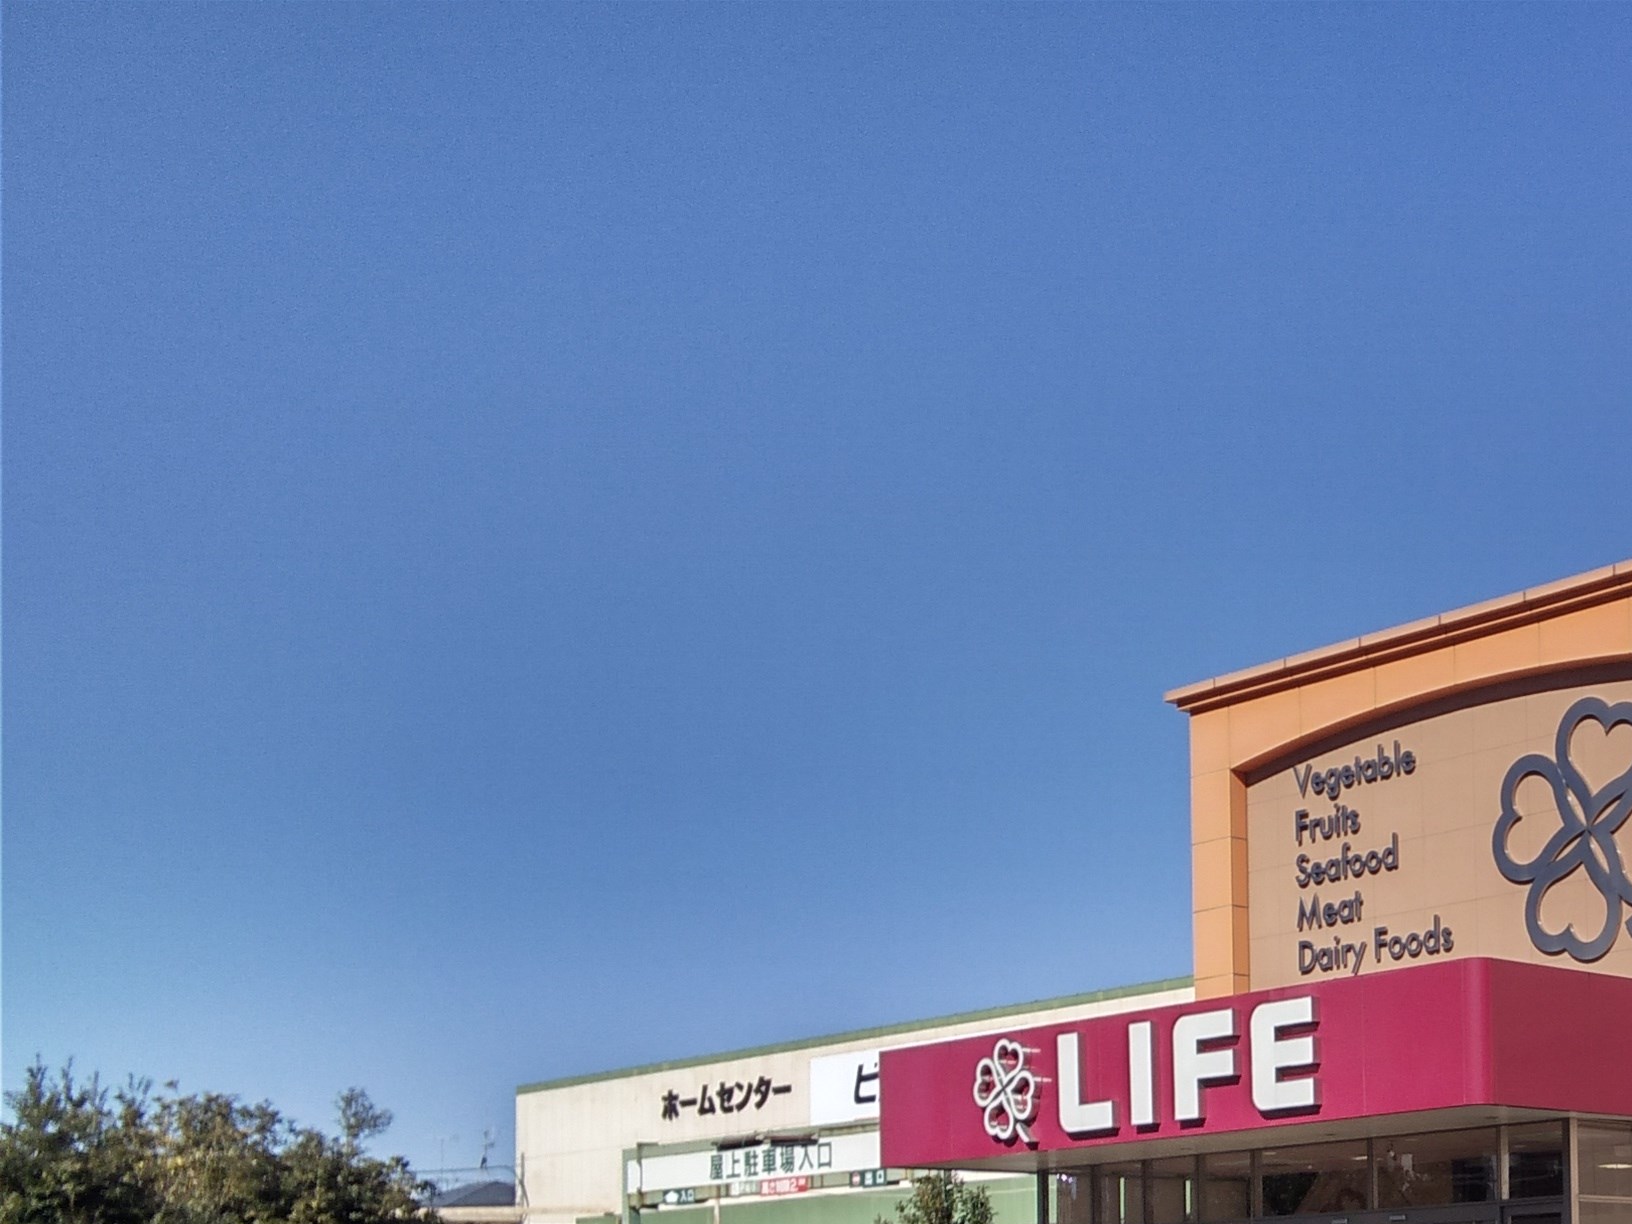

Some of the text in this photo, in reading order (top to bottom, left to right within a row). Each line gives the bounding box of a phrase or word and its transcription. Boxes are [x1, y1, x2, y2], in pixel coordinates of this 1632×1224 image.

[1294, 739, 1416, 799] Vegetable
[1295, 803, 1361, 845] Fruits
[1295, 833, 1399, 887] Seafood
[1296, 890, 1363, 931] Meat
[1298, 914, 1454, 976] Dairy Foods
[1056, 995, 1320, 1138] LIFE
[661, 1076, 793, 1122] ホームセンター
[709, 1141, 832, 1181] 屋上駐車場入口
